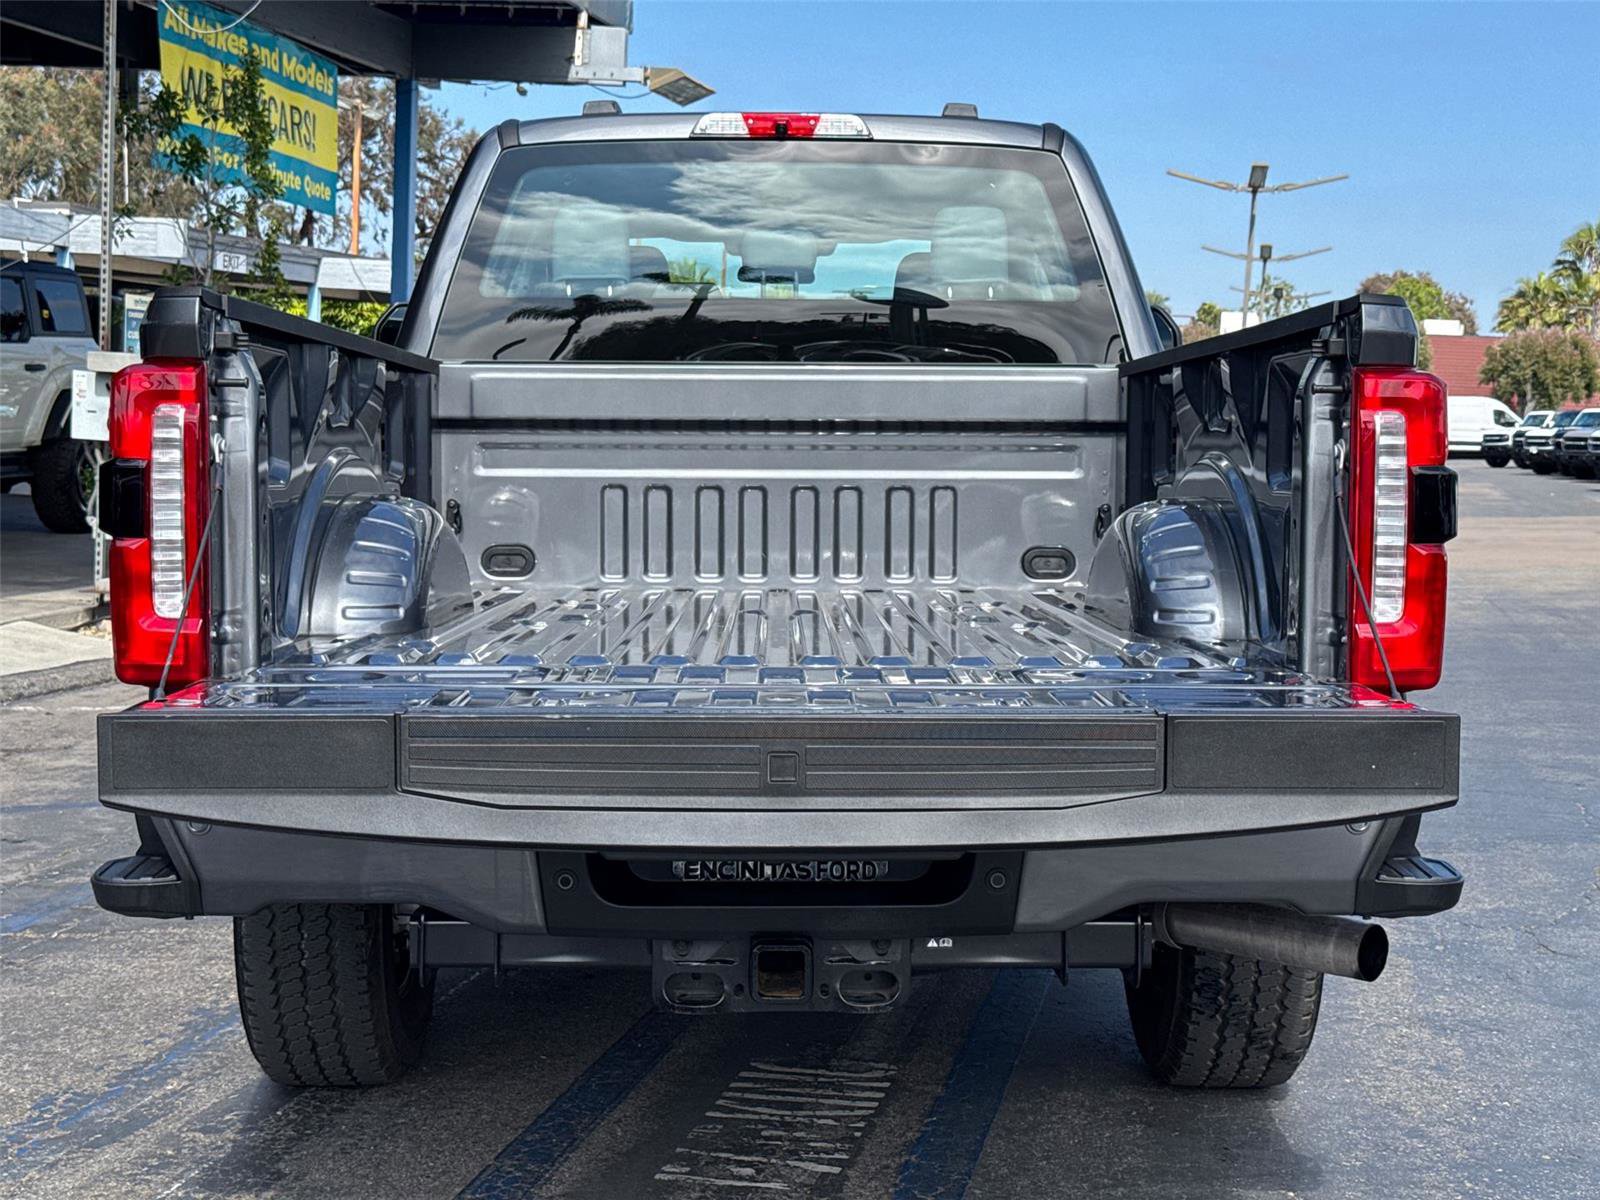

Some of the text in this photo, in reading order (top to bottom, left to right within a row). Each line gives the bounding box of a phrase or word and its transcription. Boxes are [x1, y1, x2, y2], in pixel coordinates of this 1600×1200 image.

[164, 5, 334, 96] All Makes and Models
[267, 95, 316, 152] CARS!
[213, 146, 240, 170] For
[304, 174, 332, 201] Quote
[223, 254, 240, 269] EXIT
